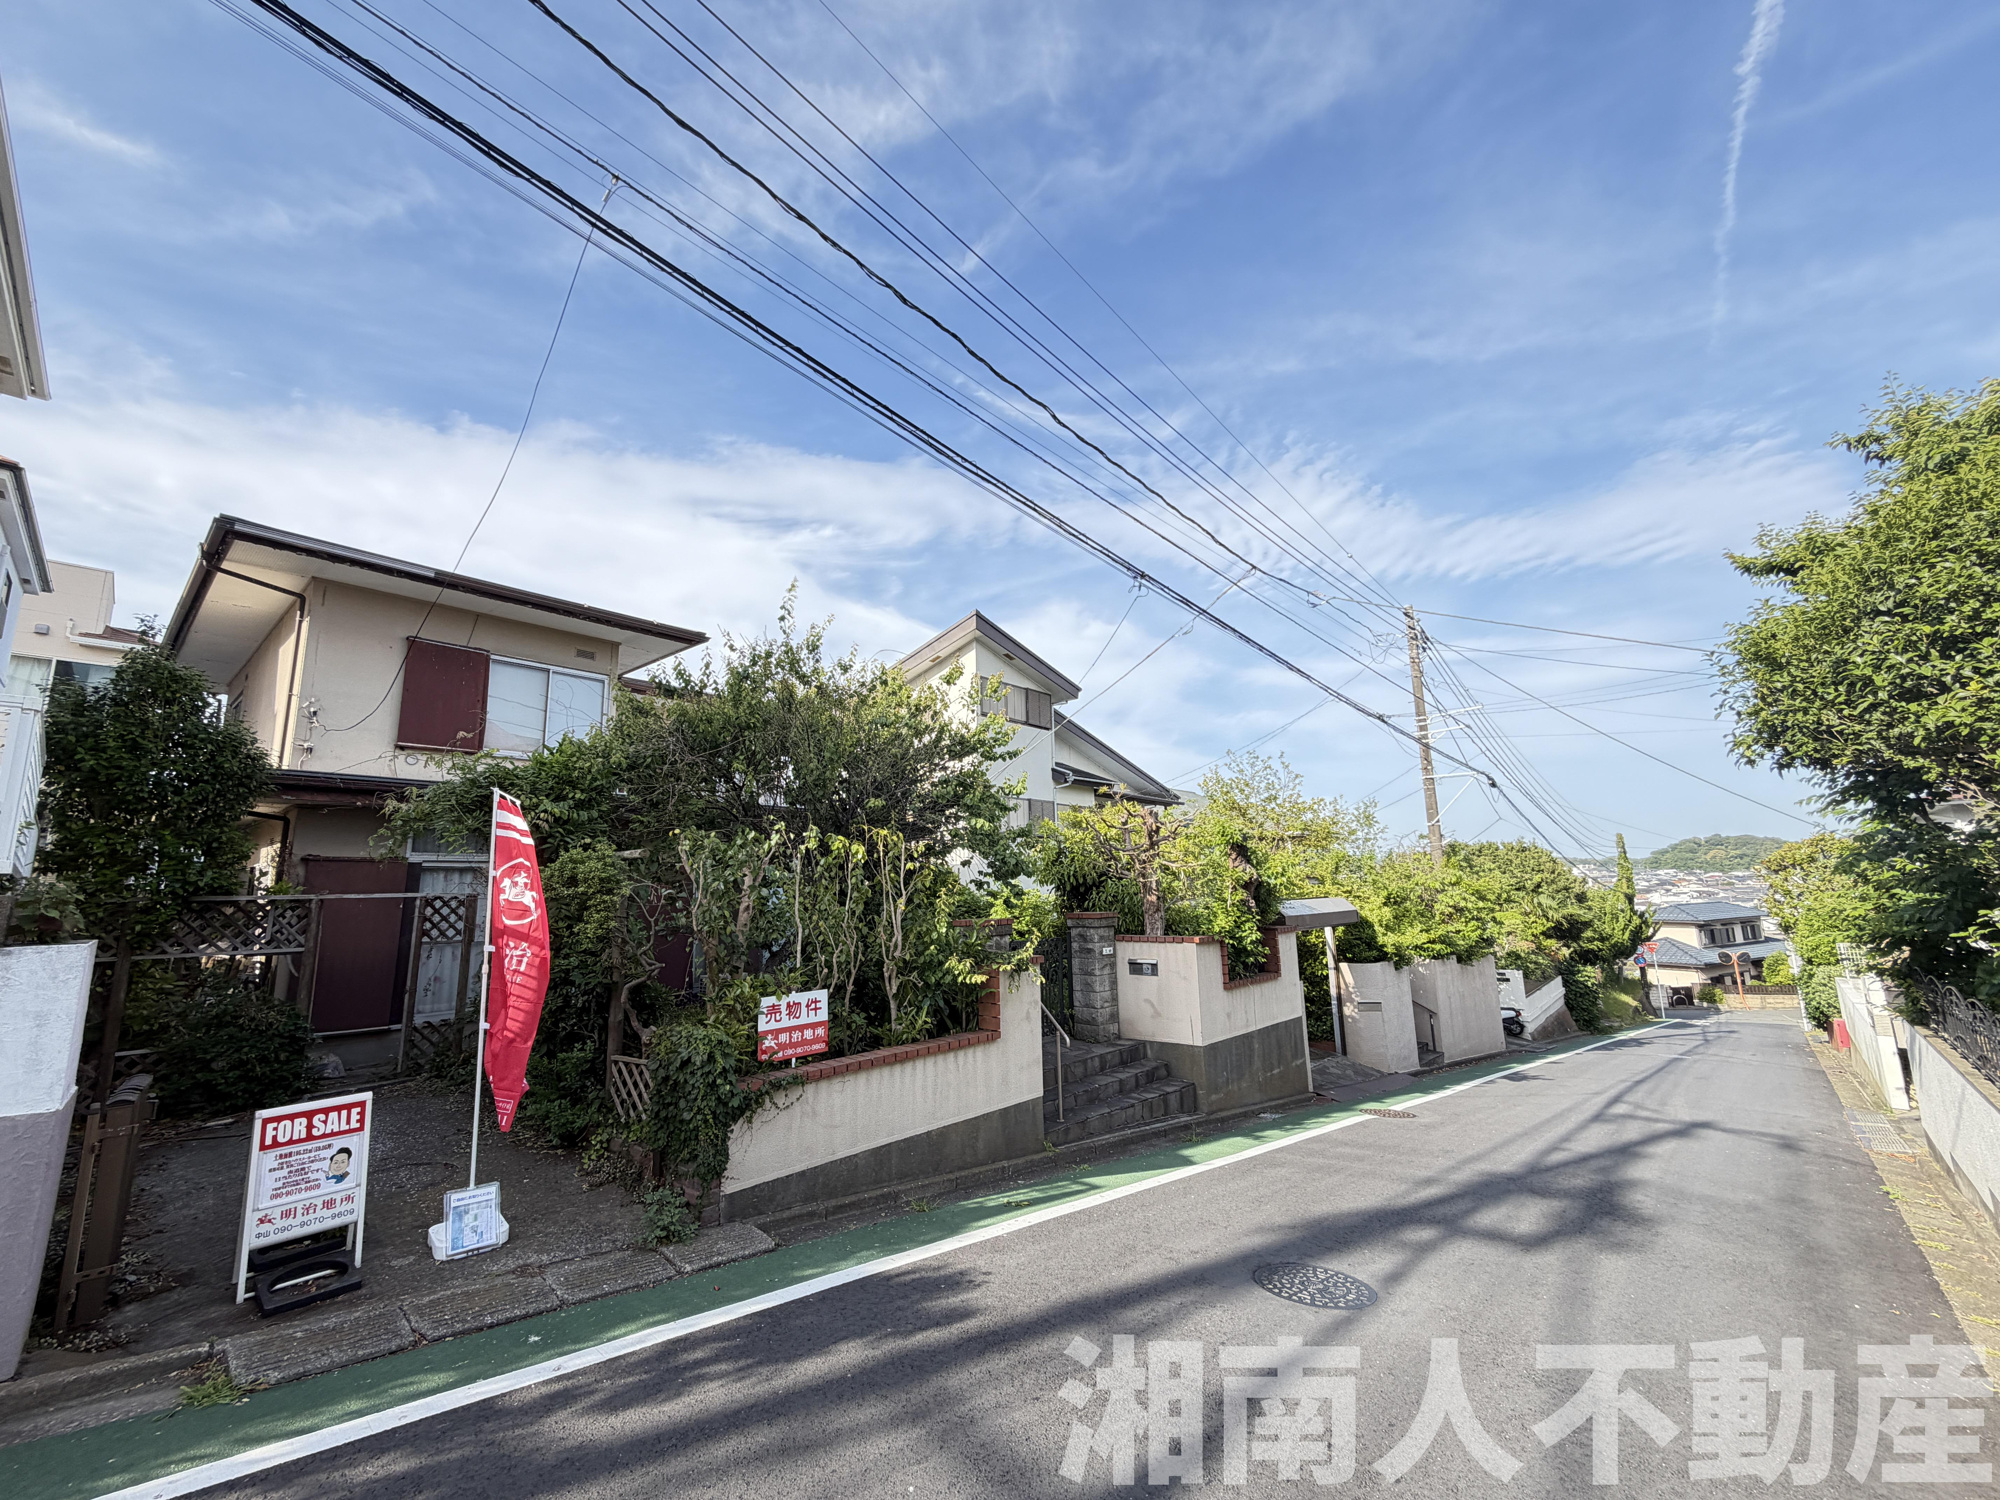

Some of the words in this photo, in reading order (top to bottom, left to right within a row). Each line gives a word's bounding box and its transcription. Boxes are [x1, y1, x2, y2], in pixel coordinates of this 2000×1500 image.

[765, 997, 822, 1024] 売物件
[778, 1026, 826, 1044] 明治地所
[265, 1117, 307, 1146] FOR
[312, 1107, 361, 1136] SALE
[270, 1183, 321, 1200] 090-9070-9609
[280, 1192, 356, 1221] 明治地所
[255, 1230, 271, 1240] 中山
[273, 1208, 355, 1235] 090-9070-9609
